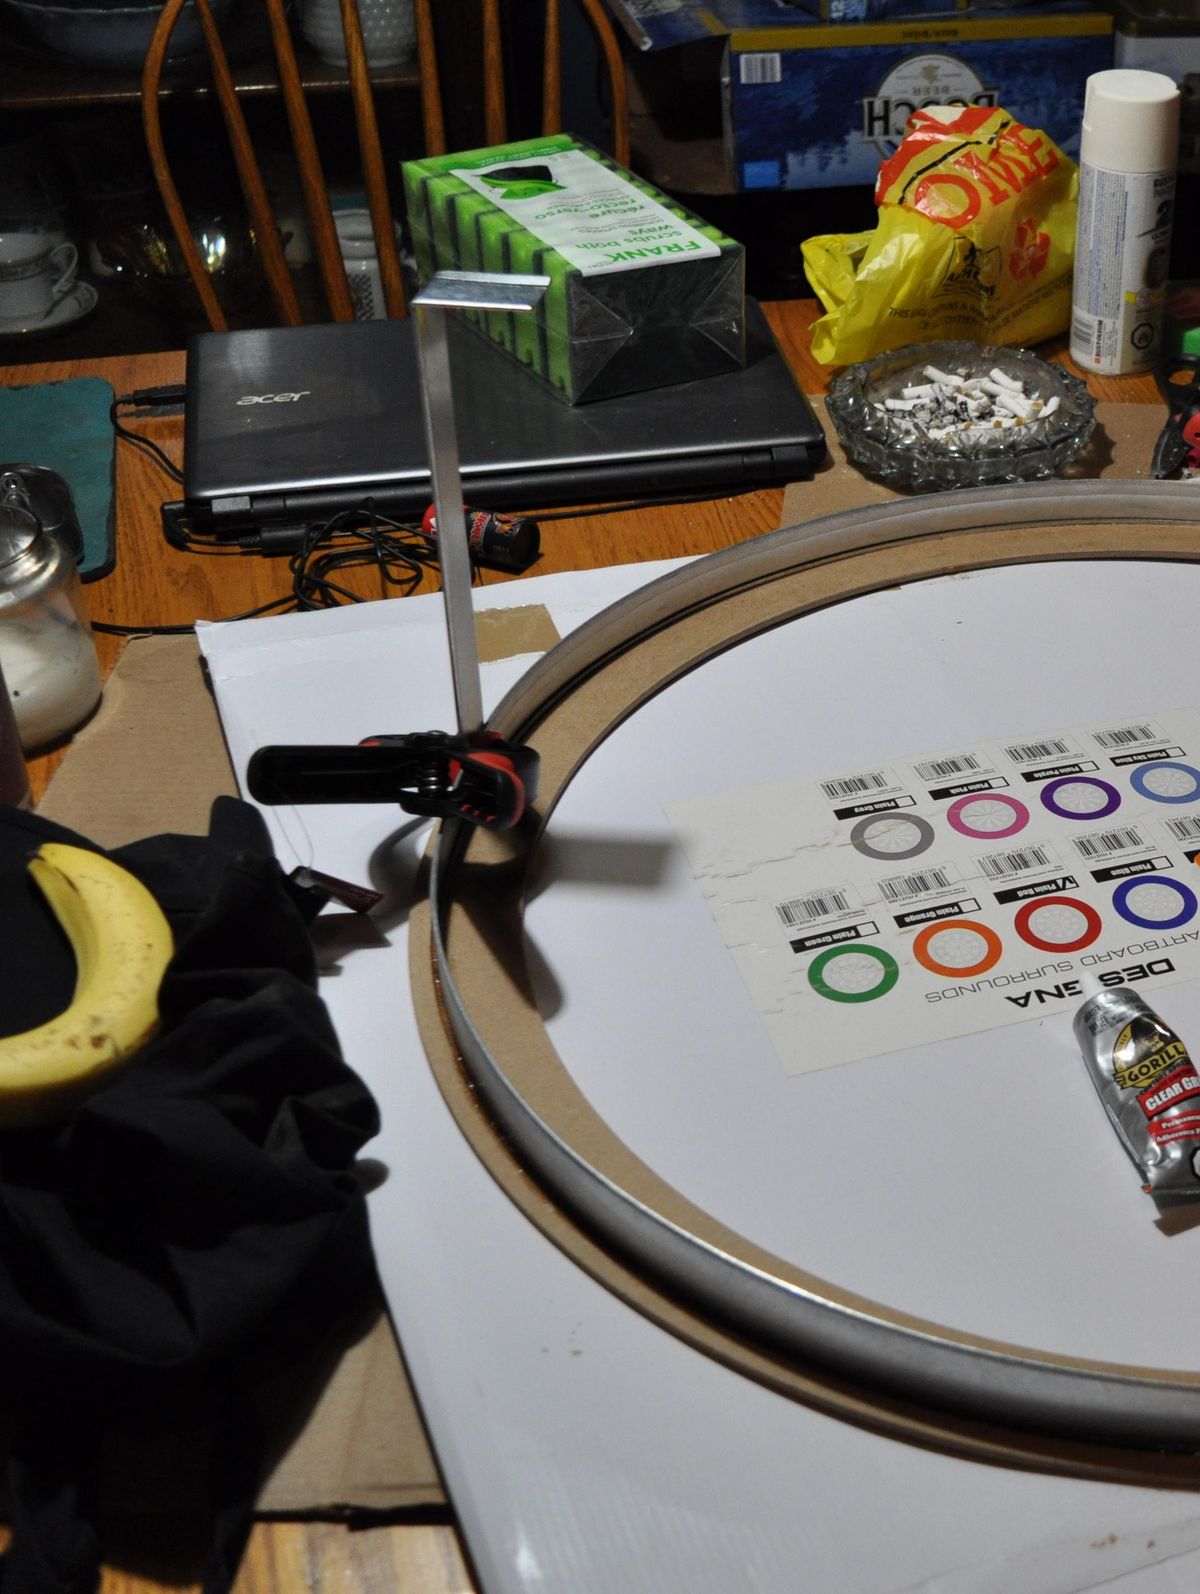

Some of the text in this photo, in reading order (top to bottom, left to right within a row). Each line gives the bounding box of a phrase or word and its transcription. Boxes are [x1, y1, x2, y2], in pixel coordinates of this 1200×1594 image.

[912, 85, 949, 96] BEER
[628, 224, 674, 235] ways
[576, 230, 683, 250] scrubs both
[605, 240, 703, 263] FRANK
[236, 391, 311, 405] acer
[1114, 756, 1131, 764] Blue
[1147, 750, 1167, 758] Plain
[1033, 765, 1080, 778] Plain Purple
[949, 783, 990, 795] Plain Pink
[853, 800, 896, 814] Plain Grey
[1110, 862, 1152, 876] Plain Blue
[1017, 884, 1058, 898] Plain Red
[904, 905, 960, 923] Plain Orange
[804, 930, 857, 947] Plain Green
[925, 960, 1074, 1003] SURROUNDS
[1005, 957, 1176, 1008] DESGNA
[1127, 1043, 1187, 1082] GORILL
[1145, 1081, 1183, 1110] CLEAR
